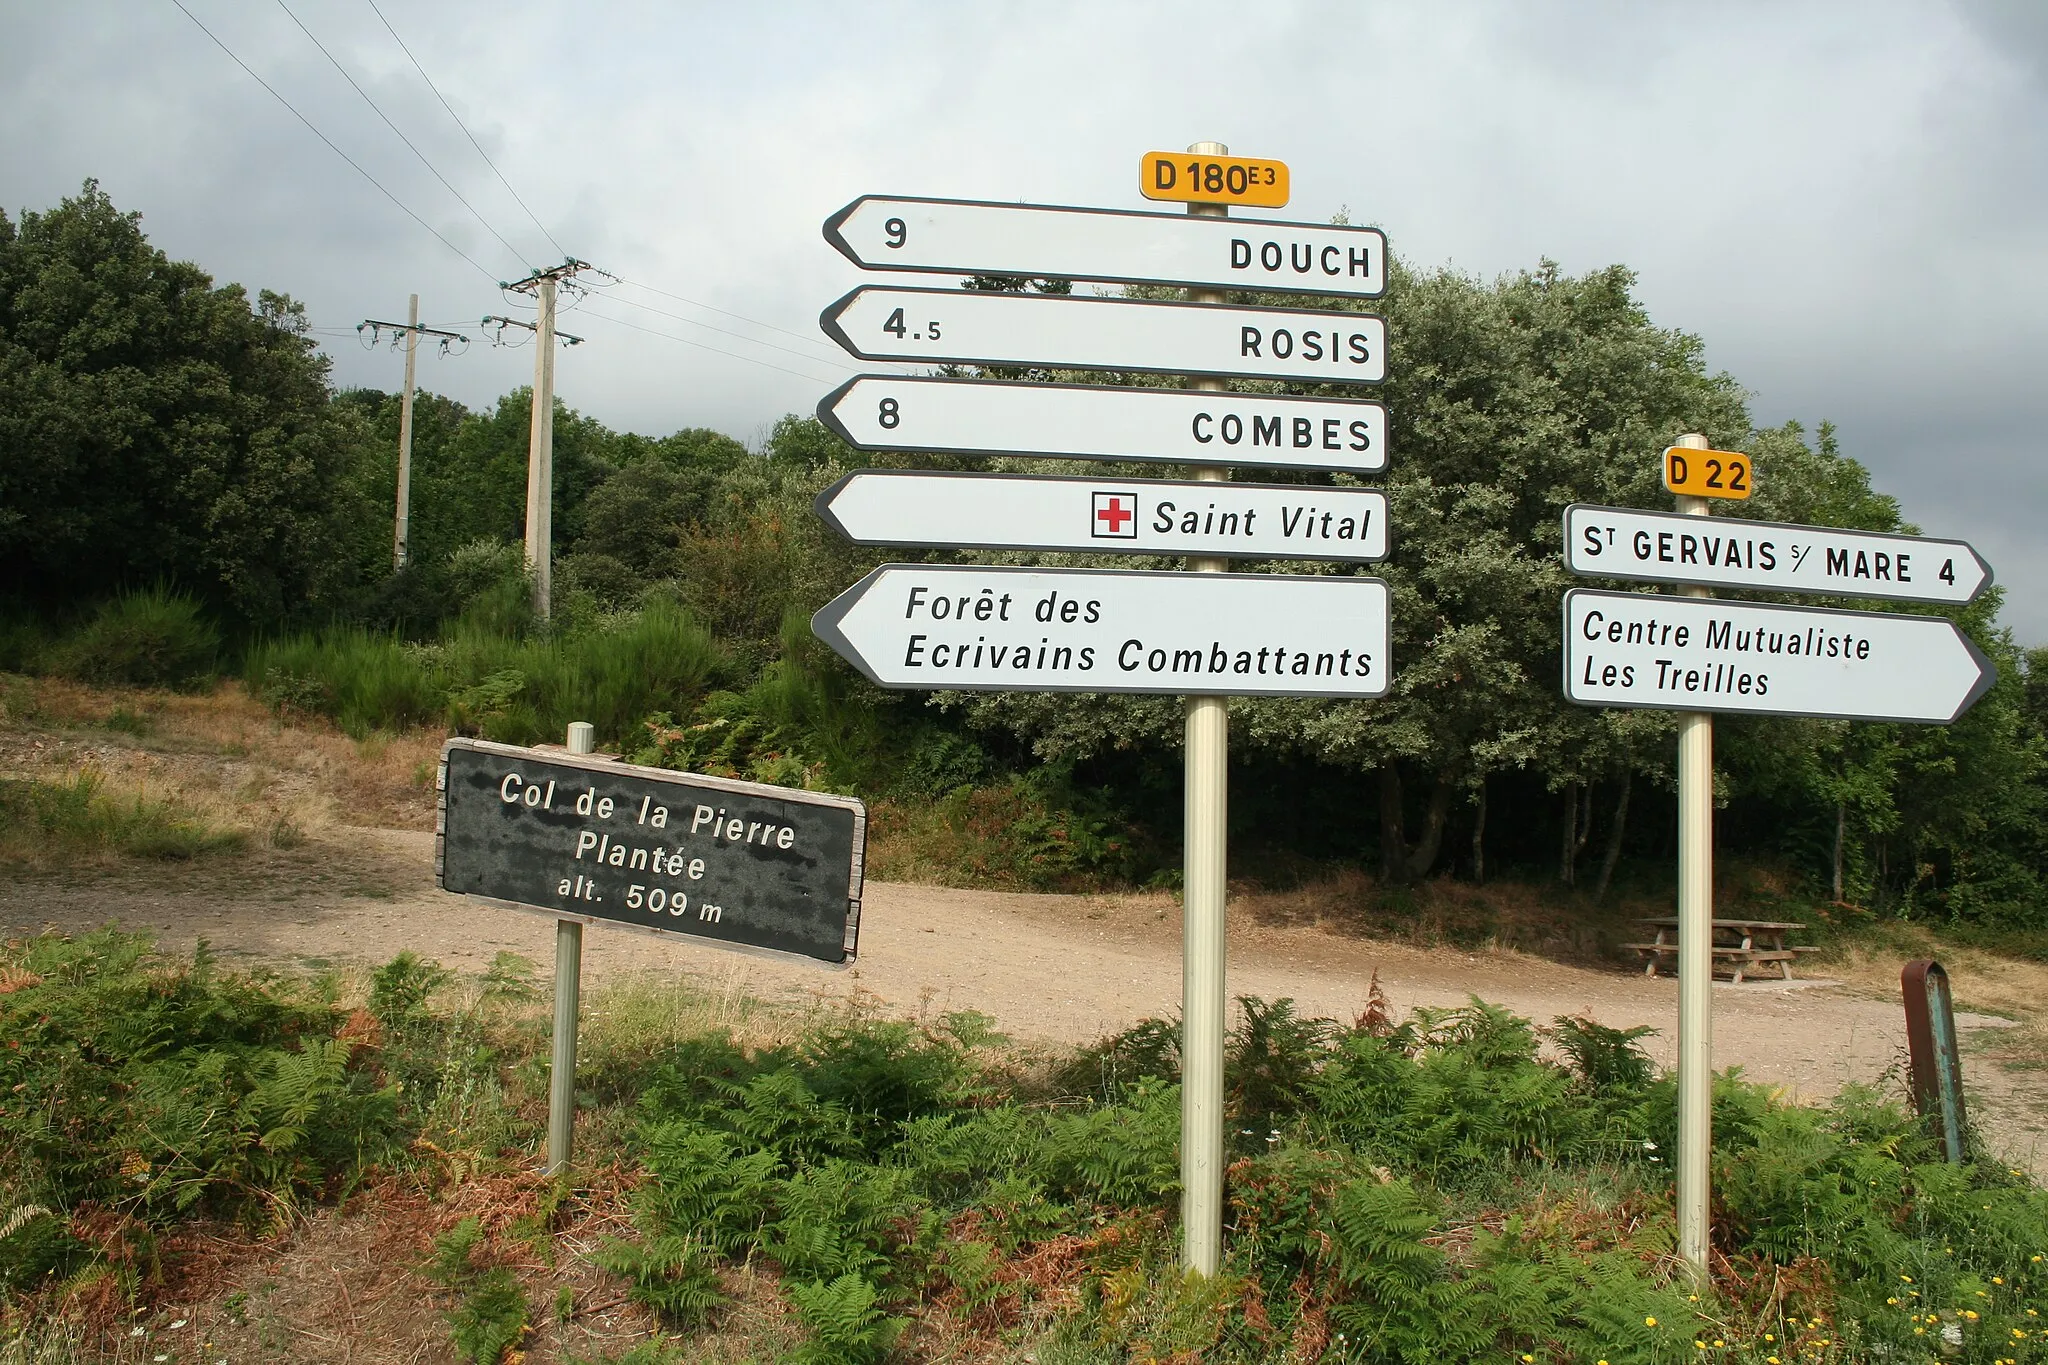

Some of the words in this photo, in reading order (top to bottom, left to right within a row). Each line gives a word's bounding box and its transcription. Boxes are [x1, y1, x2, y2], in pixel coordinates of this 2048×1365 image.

[1156, 160, 1176, 189] D
[885, 218, 906, 248] 9
[1232, 239, 1368, 277] DOUCH
[1242, 327, 1369, 363] ROSIS
[879, 398, 899, 429] 8
[1193, 413, 1370, 451] COMBES
[1671, 456, 1687, 484] D
[1706, 460, 1745, 490] 22
[1153, 502, 1256, 536] Saint
[1282, 507, 1370, 540] Vital
[1634, 531, 1776, 570] GERVAIS
[1827, 548, 1911, 582] MARE
[1939, 559, 1955, 586] 4
[906, 587, 1012, 621] Forêt
[1036, 591, 1100, 623] des
[1584, 611, 1689, 647] Centre
[1706, 620, 1869, 659] Mutualiste
[905, 635, 1095, 670] Ecrivains
[1119, 640, 1371, 676] Combattants
[1584, 656, 1634, 687] Les
[1656, 660, 1768, 695] Treilles
[501, 774, 555, 808] Col
[577, 787, 613, 818] de
[638, 796, 668, 828] la
[691, 805, 794, 848] Pierre
[576, 831, 704, 880] Plantée
[558, 875, 601, 901] alt.
[627, 885, 687, 916] 509
[700, 904, 721, 923] m
